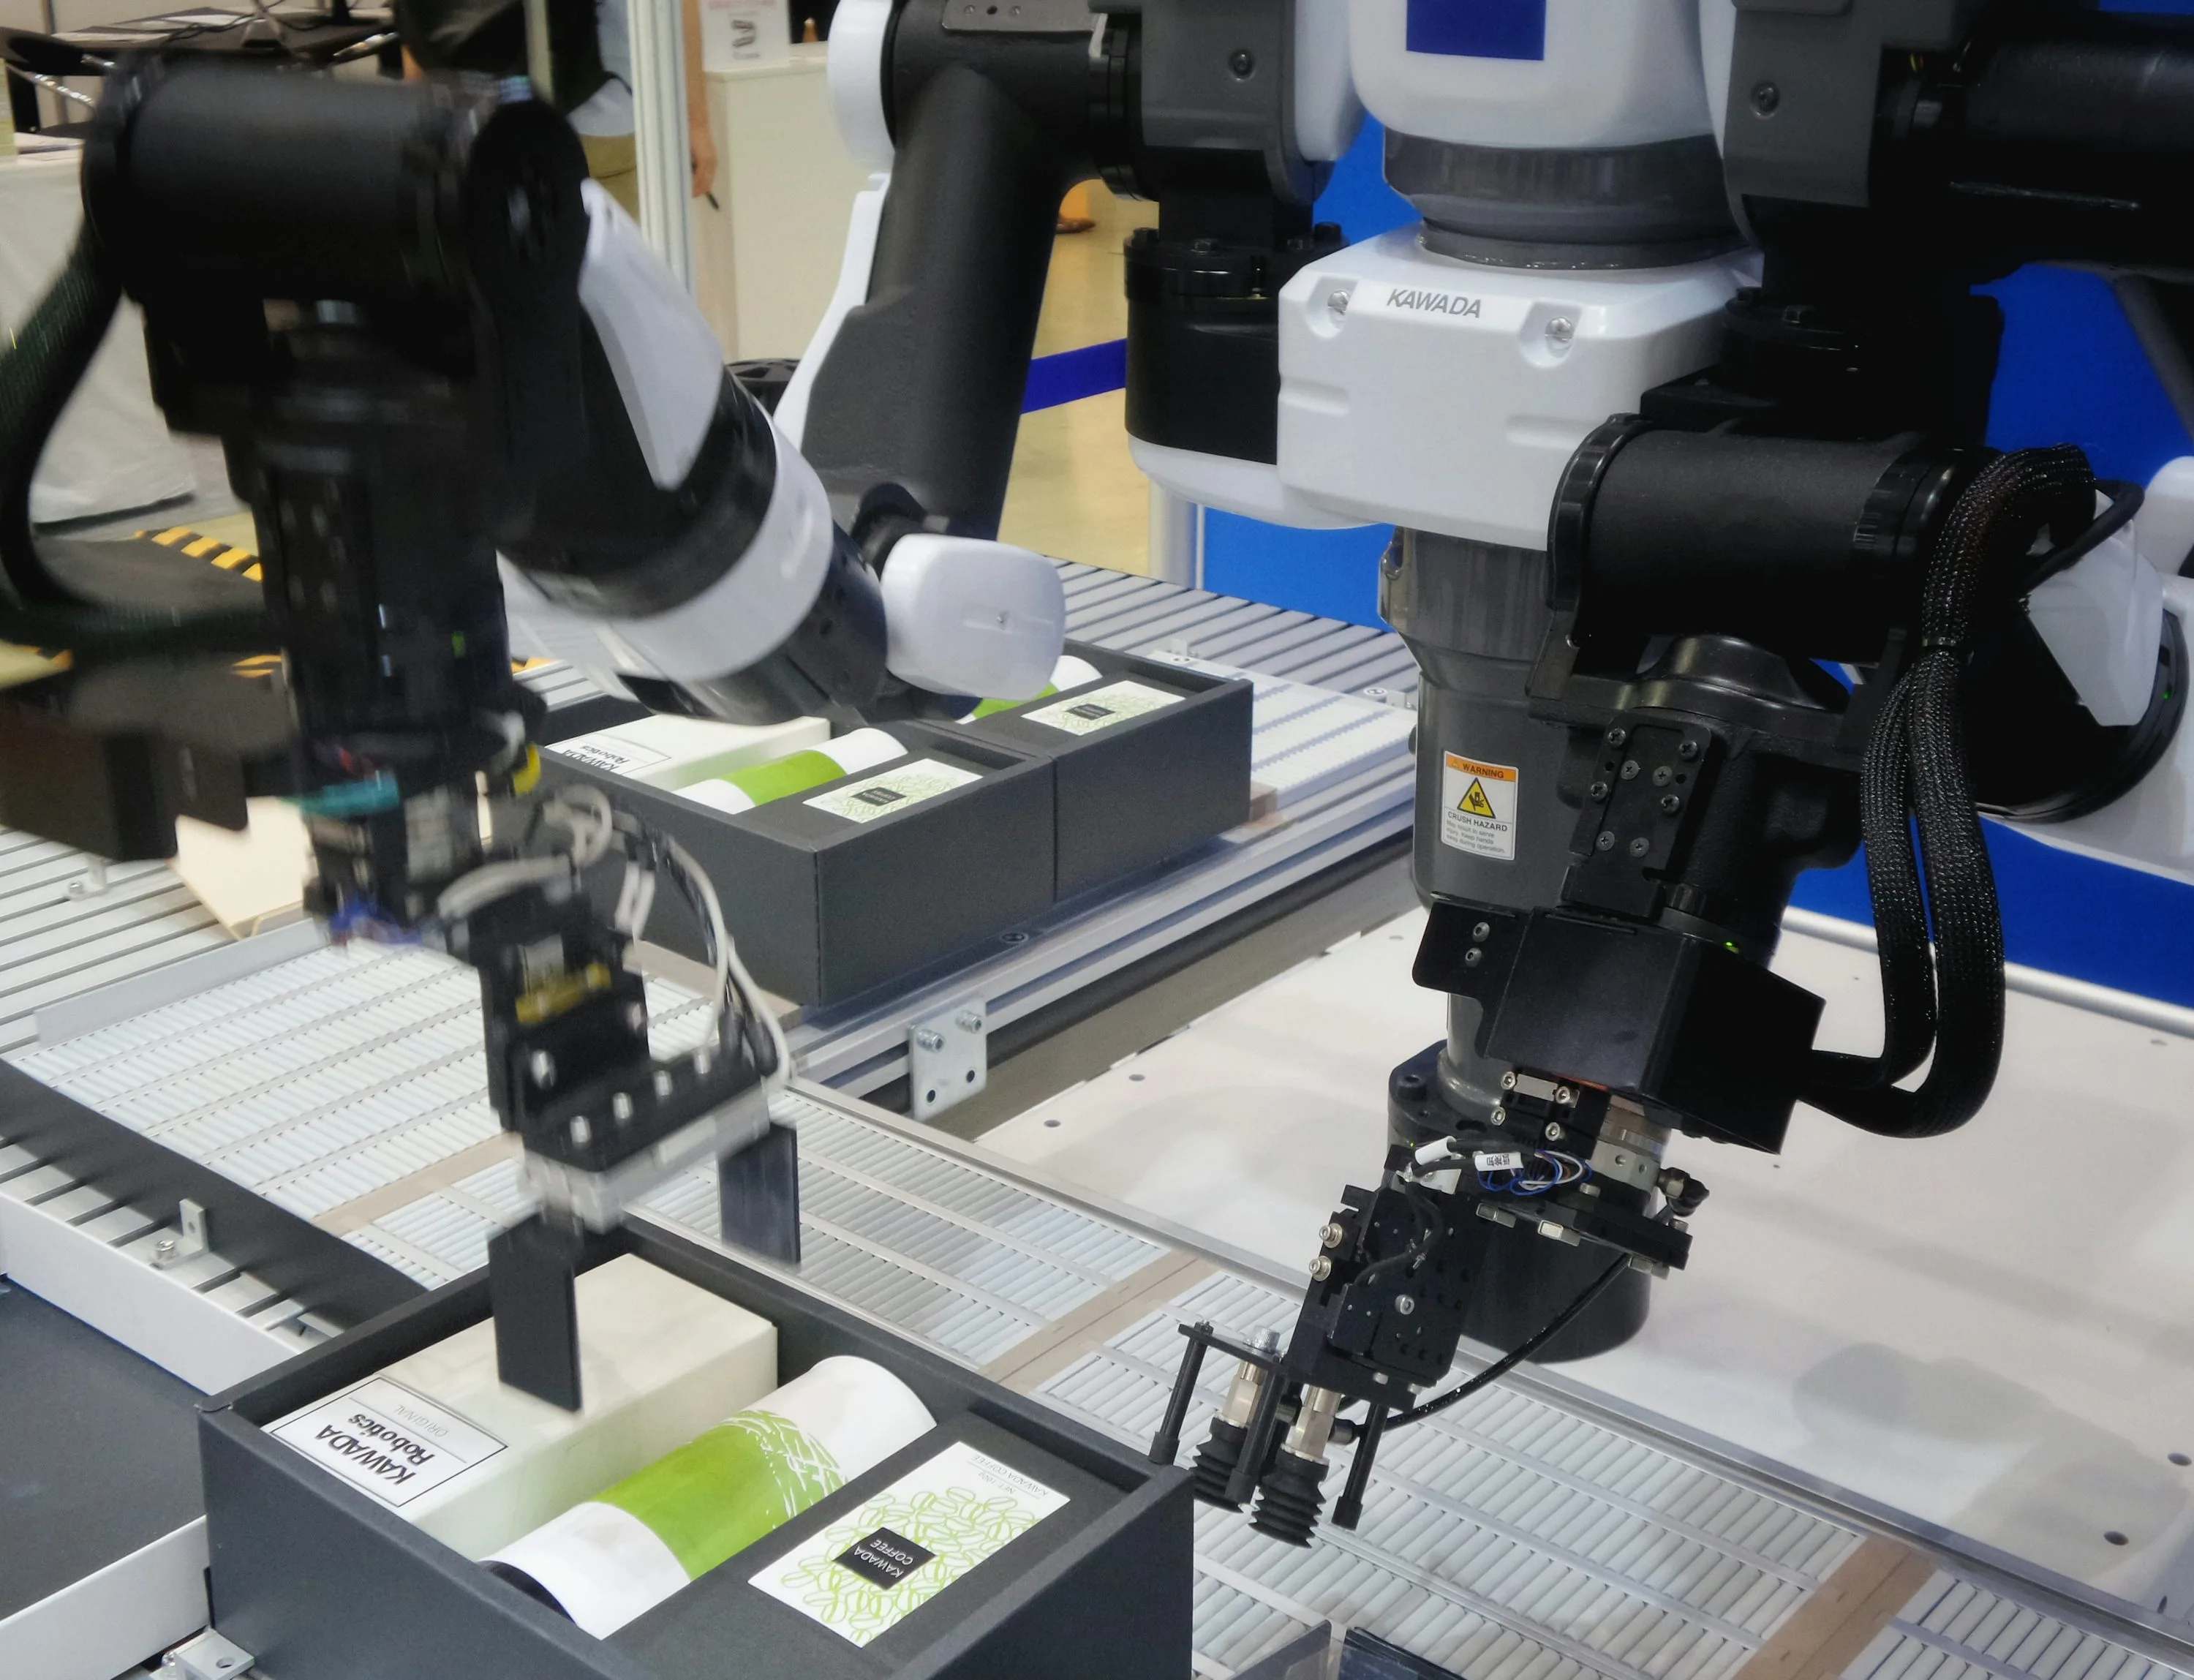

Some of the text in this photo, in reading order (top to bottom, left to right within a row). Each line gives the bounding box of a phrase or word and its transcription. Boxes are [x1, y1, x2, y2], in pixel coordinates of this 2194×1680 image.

[1386, 288, 1482, 318] KAWADA
[581, 745, 630, 764] Robotics
[1463, 763, 1504, 779] WARNING
[1448, 811, 1508, 832] CRUSH HAZARD
[392, 1404, 448, 1438] ORIGINAL
[314, 1425, 417, 1485] KAWADA
[347, 1413, 435, 1466] Robotics
[971, 1455, 1049, 1496] KAWADA COFFEE
[854, 1545, 904, 1578] KAWADA
[870, 1539, 913, 1565] COFFEE
